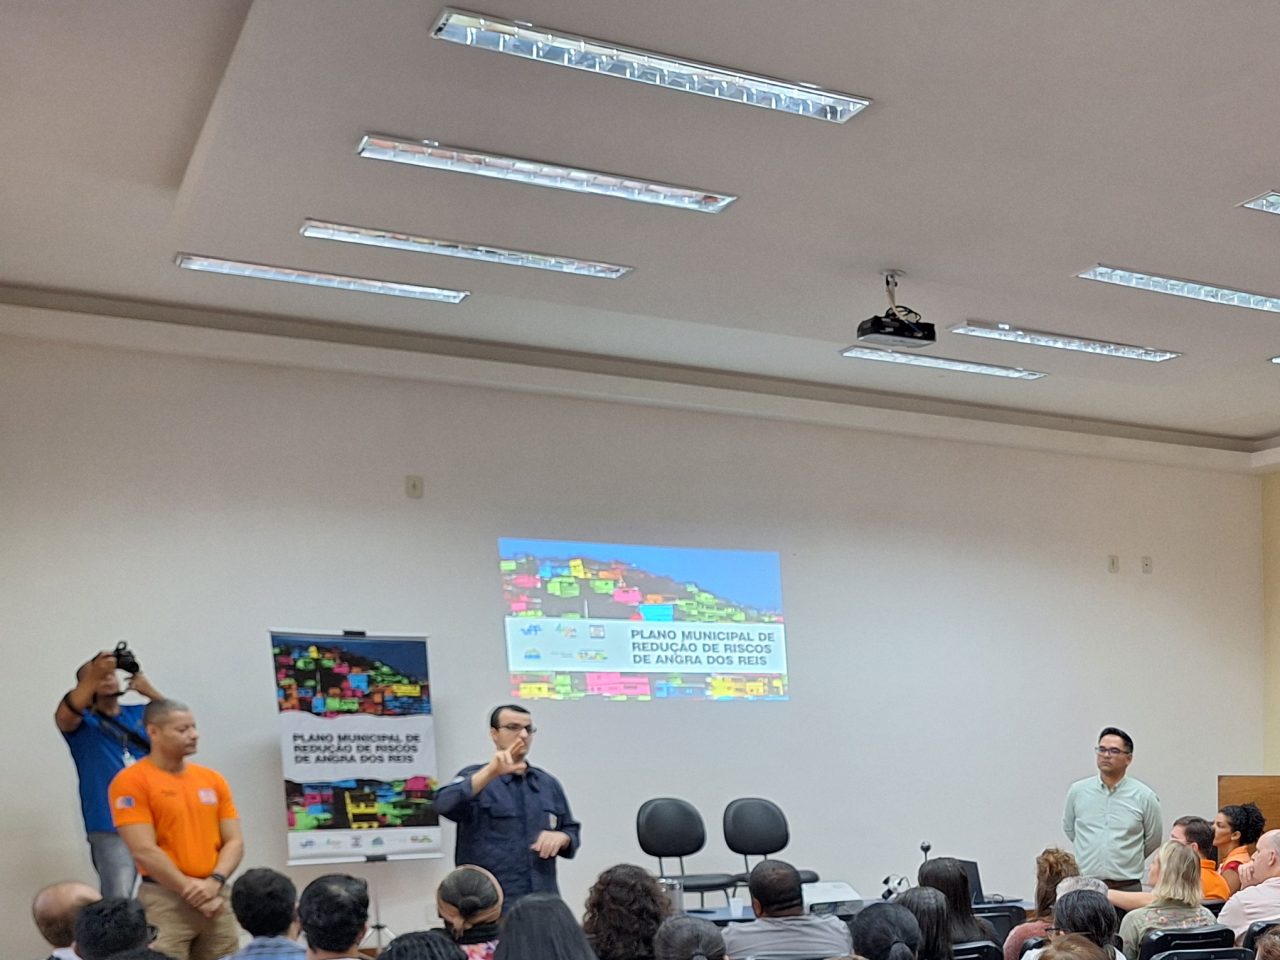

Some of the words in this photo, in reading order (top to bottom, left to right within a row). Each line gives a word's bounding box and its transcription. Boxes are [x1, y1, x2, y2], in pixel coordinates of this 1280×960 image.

[631, 629, 676, 641] PLANO
[682, 631, 754, 642] MUNICIPAL
[758, 632, 775, 643] DE
[632, 640, 699, 654] REDUÇÃO
[702, 643, 719, 653] DE
[723, 643, 772, 655] RISCOS
[633, 654, 651, 664] DE
[655, 654, 703, 665] ANGRA
[707, 655, 734, 665] DOS
[739, 655, 767, 666] REIS
[292, 733, 333, 742] PLANO
[337, 733, 402, 742] MUNICIPAL
[405, 734, 421, 742] DE
[294, 743, 352, 754] REDUÇÃO
[356, 744, 372, 753] DE
[375, 744, 419, 753] RISCOS
[295, 755, 310, 764] DE
[314, 755, 356, 764] ANGRA
[360, 755, 384, 764] DOS
[388, 755, 414, 764] REIS
